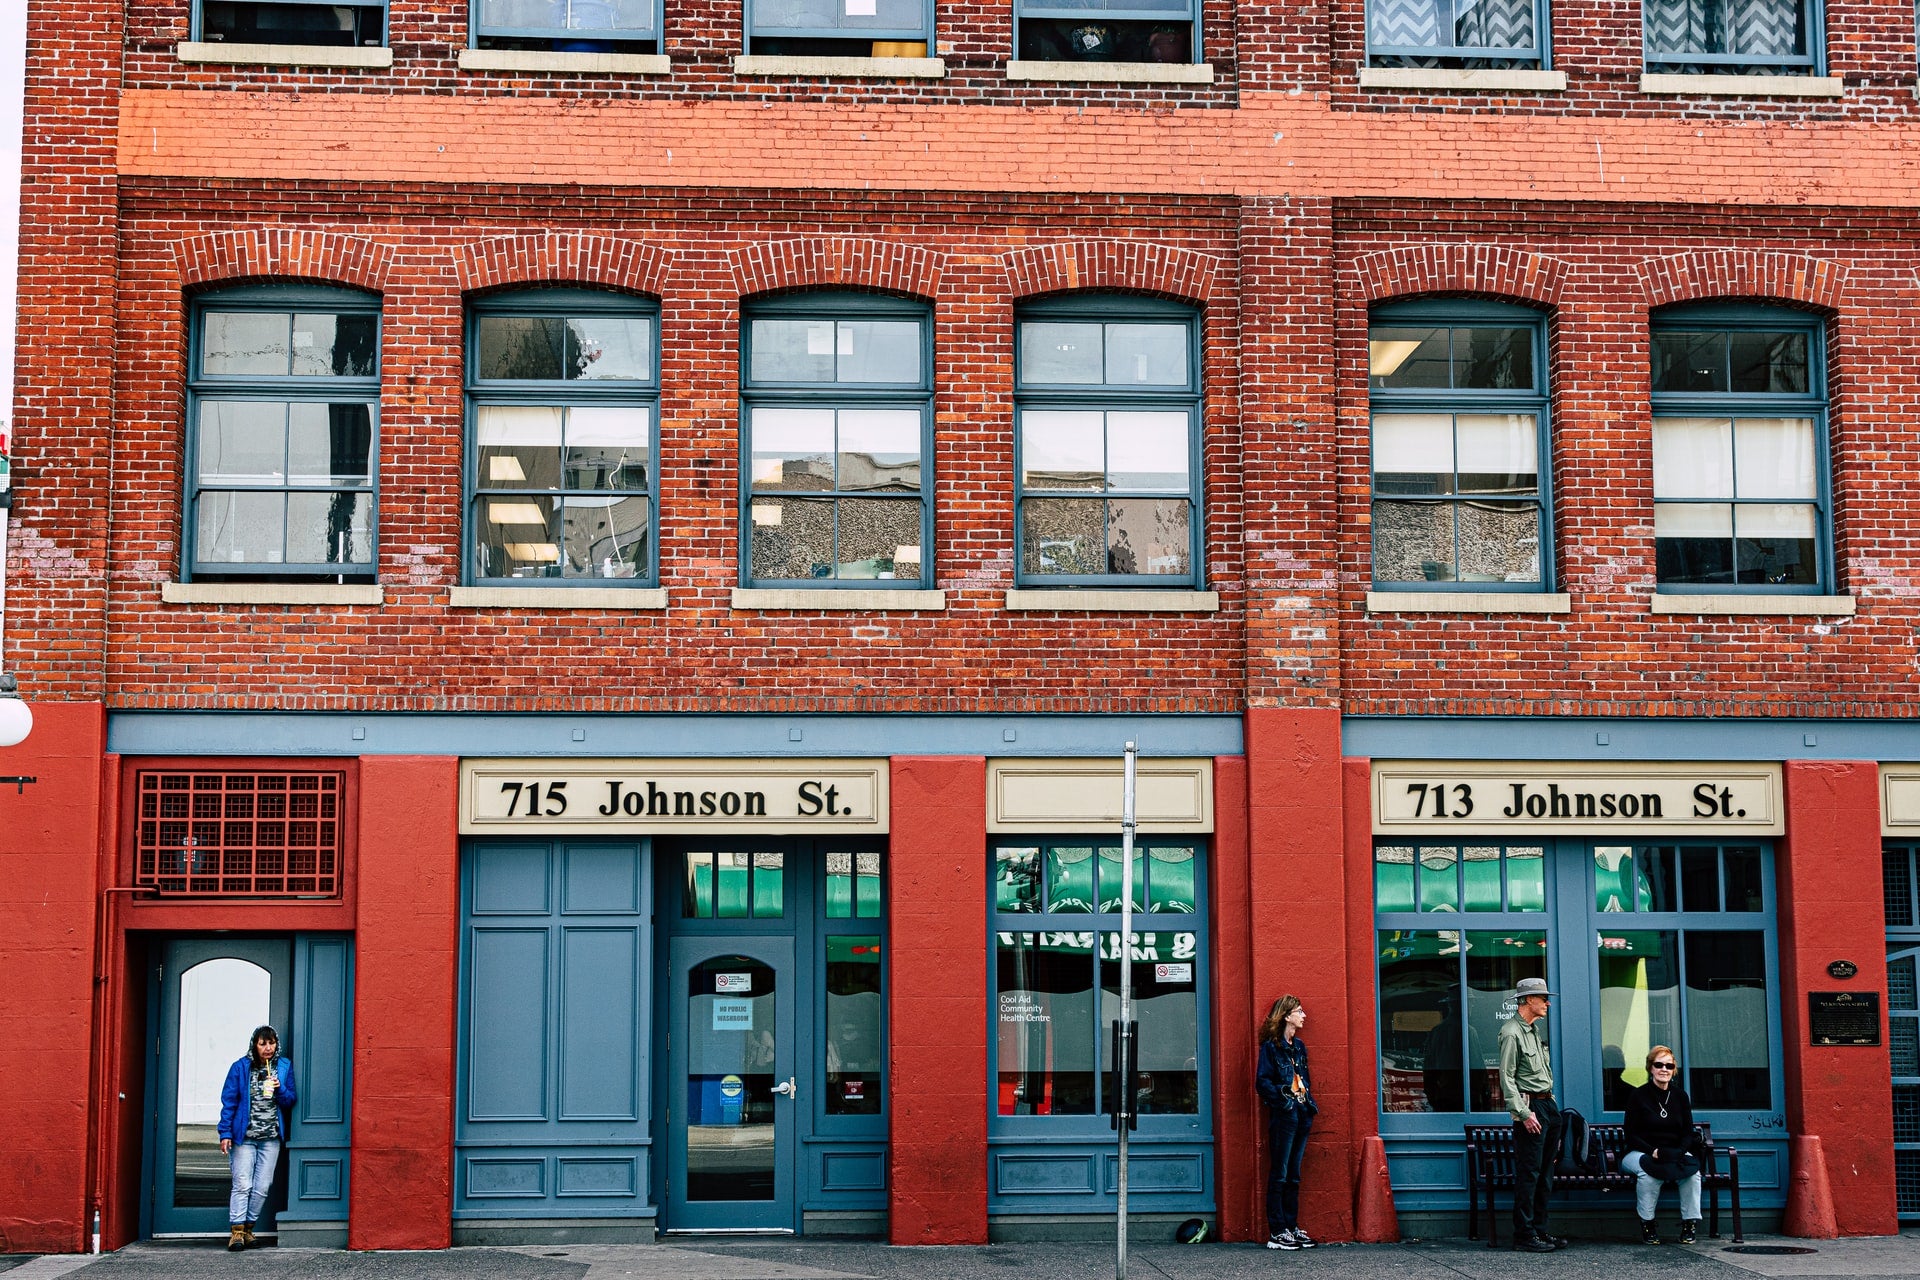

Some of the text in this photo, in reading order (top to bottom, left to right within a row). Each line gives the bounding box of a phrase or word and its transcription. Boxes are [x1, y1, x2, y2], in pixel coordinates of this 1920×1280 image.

[500, 780, 852, 817] 715 Johnson St.
[1406, 783, 1746, 818] 713 Johnson St.
[1000, 995, 1031, 1004] Cool Aid
[1000, 1004, 1043, 1014] Community
[1000, 1013, 1051, 1022] Health Centre
